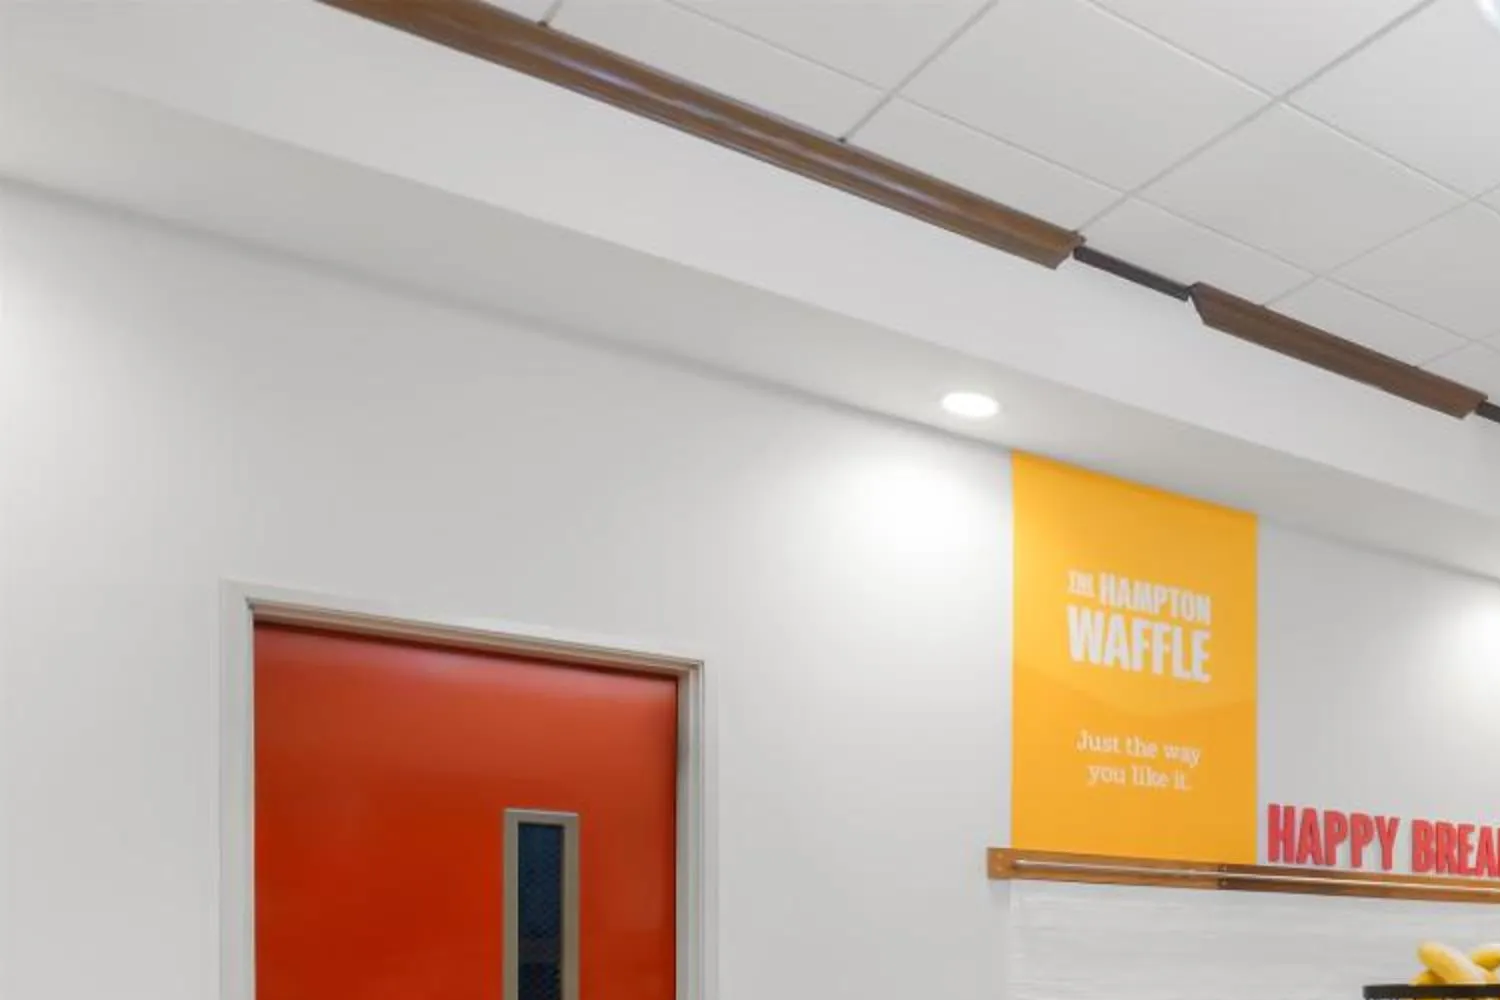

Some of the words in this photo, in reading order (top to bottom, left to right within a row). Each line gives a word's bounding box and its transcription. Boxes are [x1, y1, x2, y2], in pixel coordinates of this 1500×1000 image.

[1099, 571, 1211, 626] HAMPTON
[1066, 605, 1213, 684] WAFFLE
[1076, 728, 1120, 754] Just
[1126, 735, 1158, 759] the
[1163, 743, 1202, 769] way
[1086, 764, 1127, 789] you
[1131, 763, 1169, 788] like
[1266, 803, 1400, 871] HAPPY
